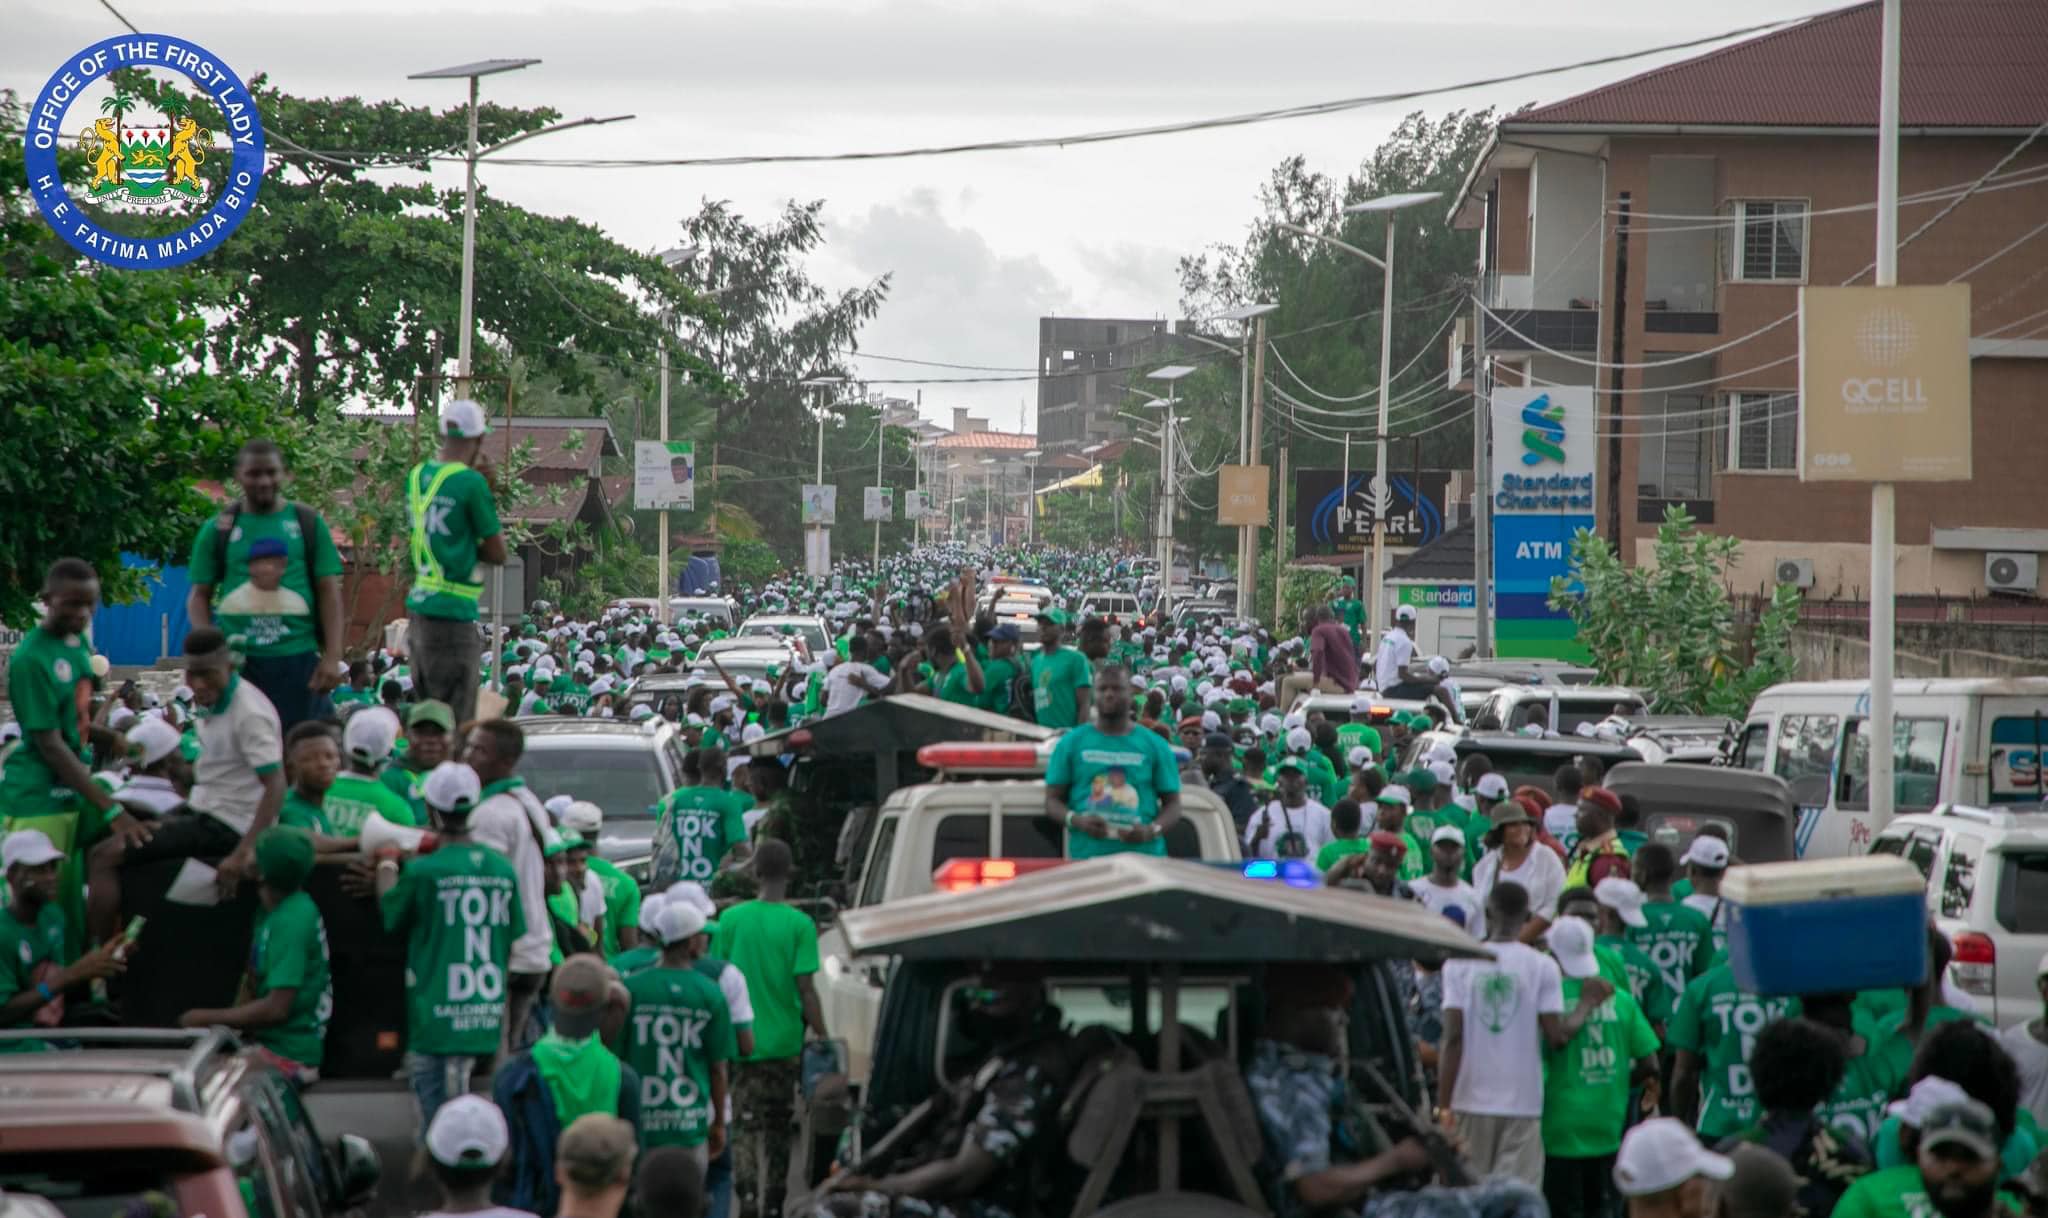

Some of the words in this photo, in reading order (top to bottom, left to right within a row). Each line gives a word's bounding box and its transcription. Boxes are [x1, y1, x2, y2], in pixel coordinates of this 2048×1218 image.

[1842, 377, 1926, 404] QCELL
[1503, 472, 1593, 491] Standard
[1495, 491, 1592, 509] Chartered
[1516, 541, 1562, 559] ATM
[1411, 588, 1472, 603] Standard
[2008, 750, 2048, 787] S
[683, 836, 703, 857] N
[437, 887, 513, 926] TOK
[464, 926, 492, 963] N
[447, 962, 504, 1000] DO
[633, 1015, 708, 1048] TOK
[657, 1046, 684, 1077] N
[1581, 1047, 1616, 1068] DO
[640, 1075, 699, 1107] DO
[1728, 1064, 1755, 1095] D
